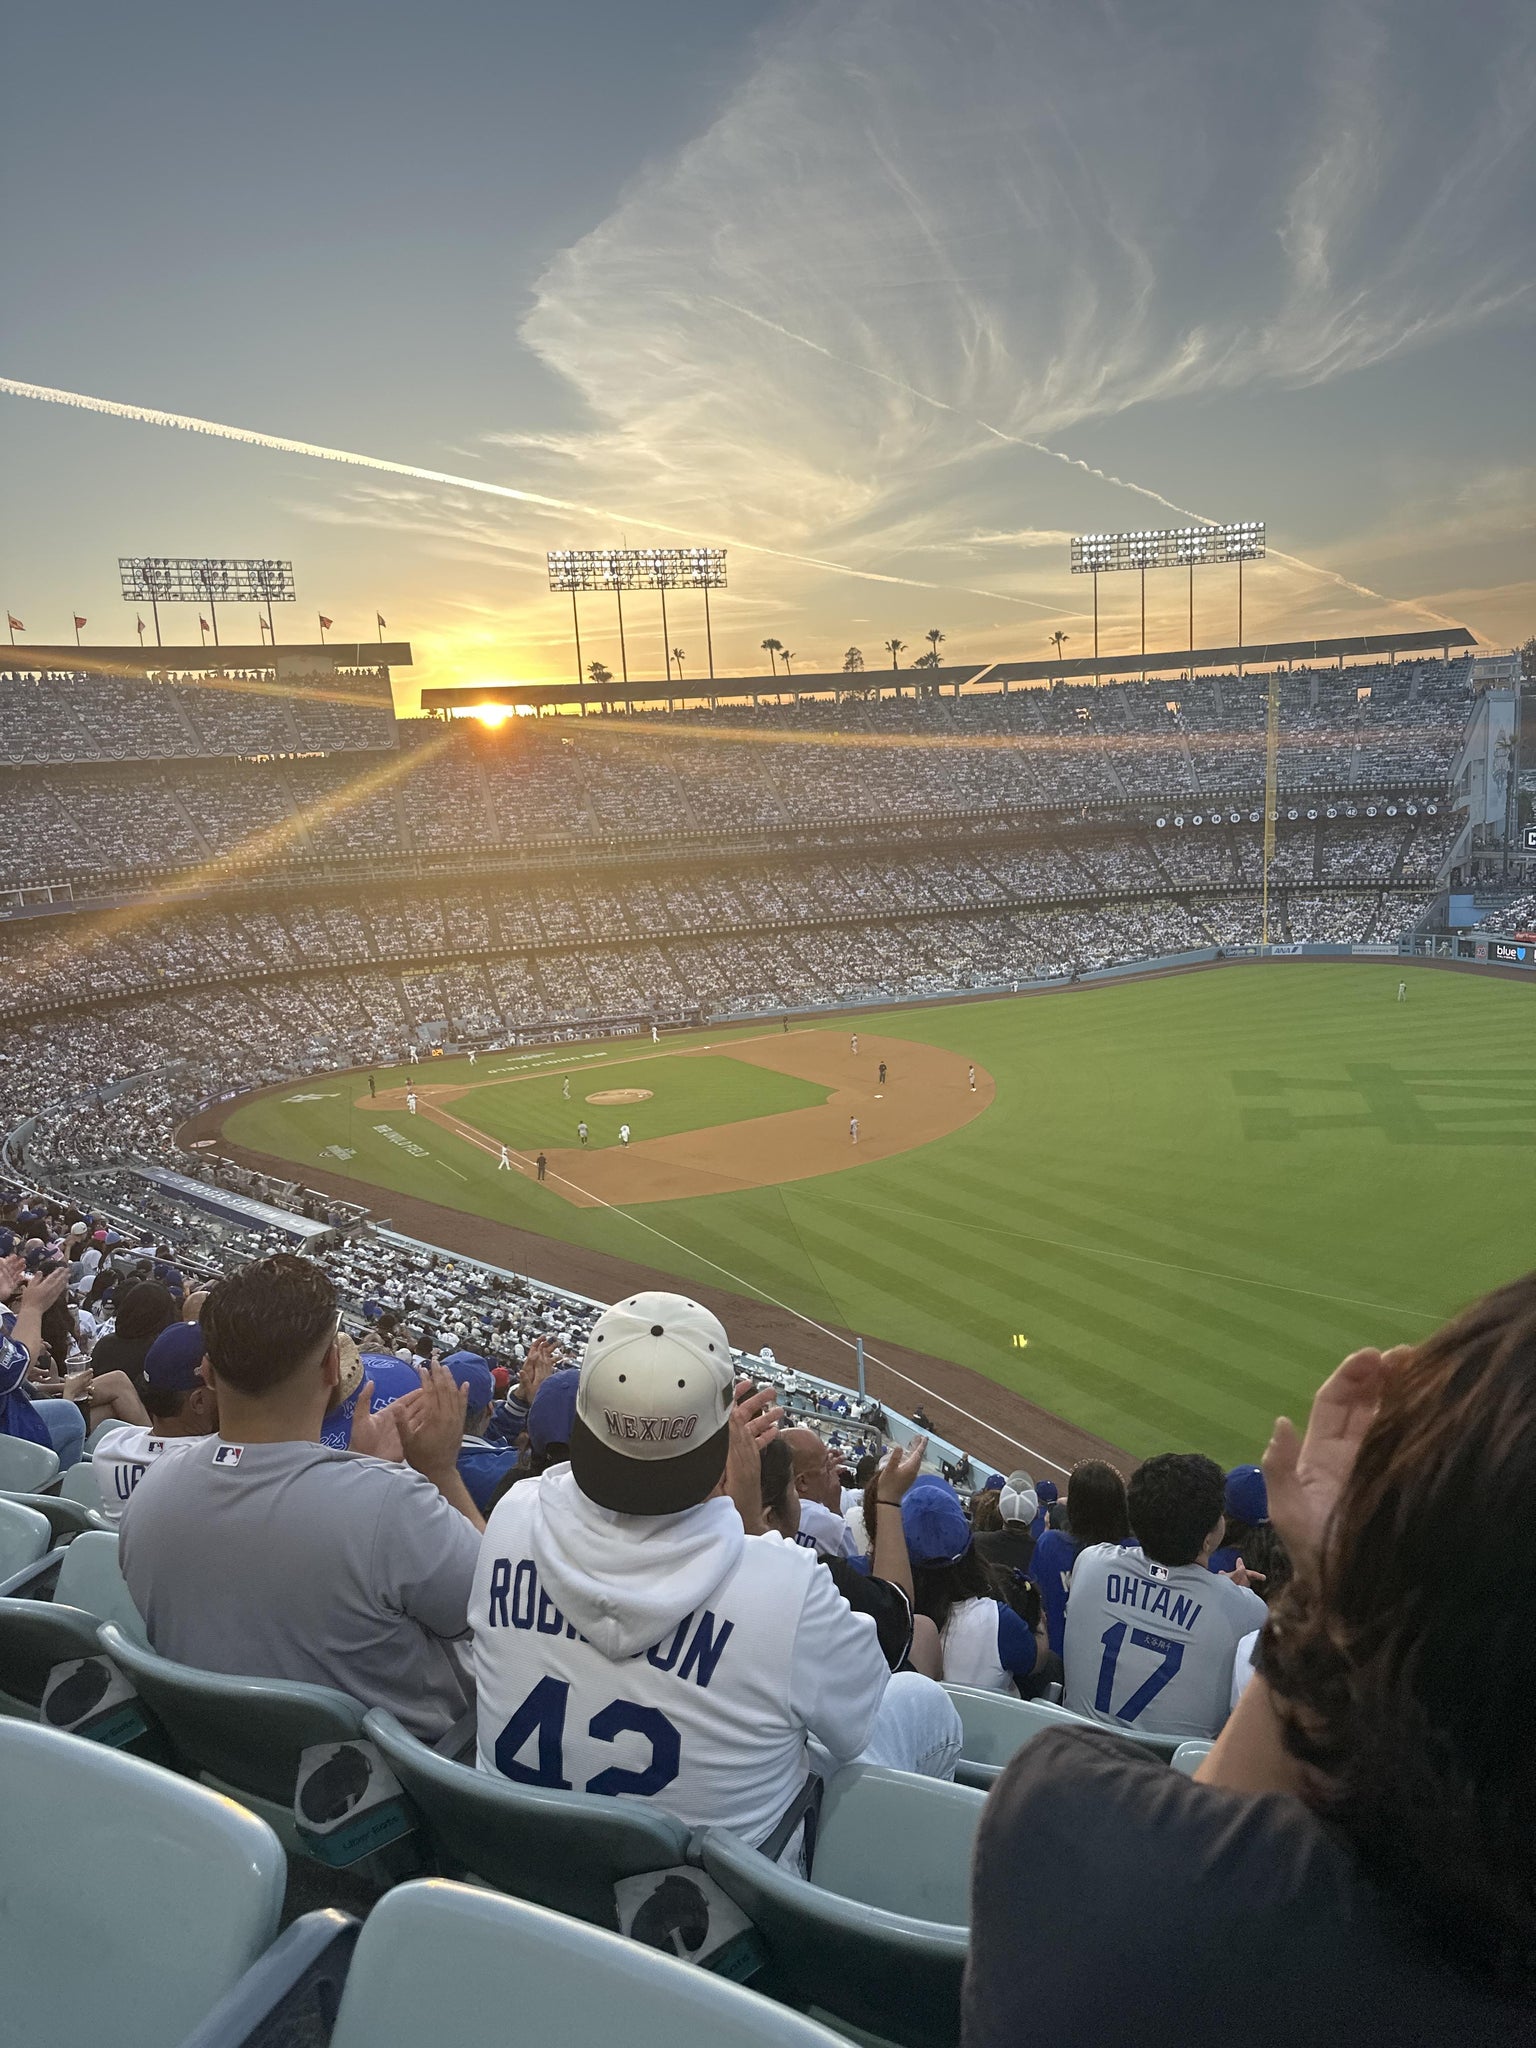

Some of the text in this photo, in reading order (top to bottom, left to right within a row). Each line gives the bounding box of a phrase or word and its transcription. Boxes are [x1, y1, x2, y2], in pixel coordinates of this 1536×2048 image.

[1497, 945, 1517, 957] blue
[183, 1181, 231, 1201] DODGER
[603, 1407, 698, 1441] MEXICO
[489, 1558, 735, 1688] ROBON
[1106, 1574, 1203, 1631] OHTANI
[1095, 1620, 1185, 1723] 17
[495, 1675, 681, 1797] 42
